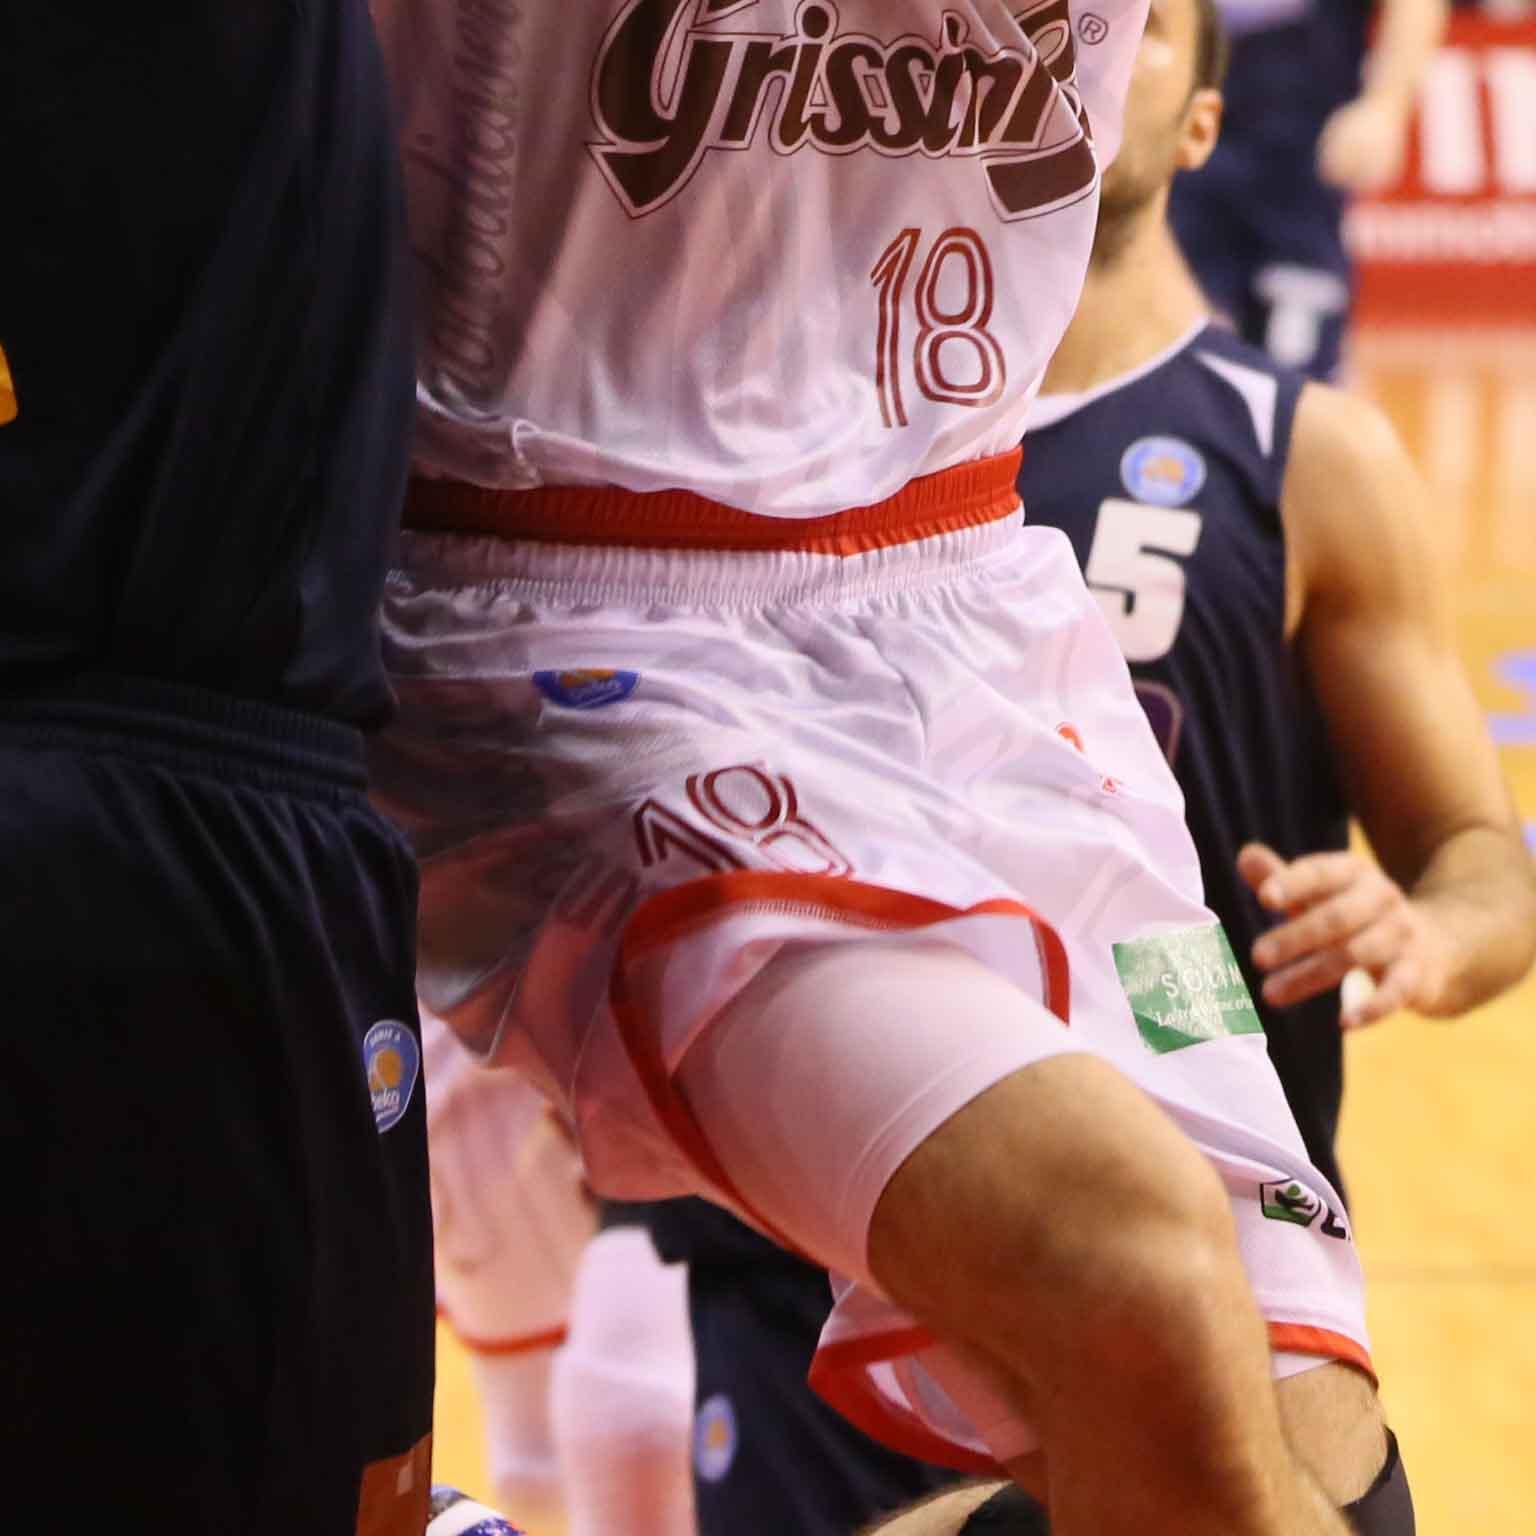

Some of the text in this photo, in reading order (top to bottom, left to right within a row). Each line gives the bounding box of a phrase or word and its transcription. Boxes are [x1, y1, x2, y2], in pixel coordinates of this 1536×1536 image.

[870, 227, 1007, 429] 18
[1086, 497, 1202, 663] 5
[634, 764, 855, 877] 18
